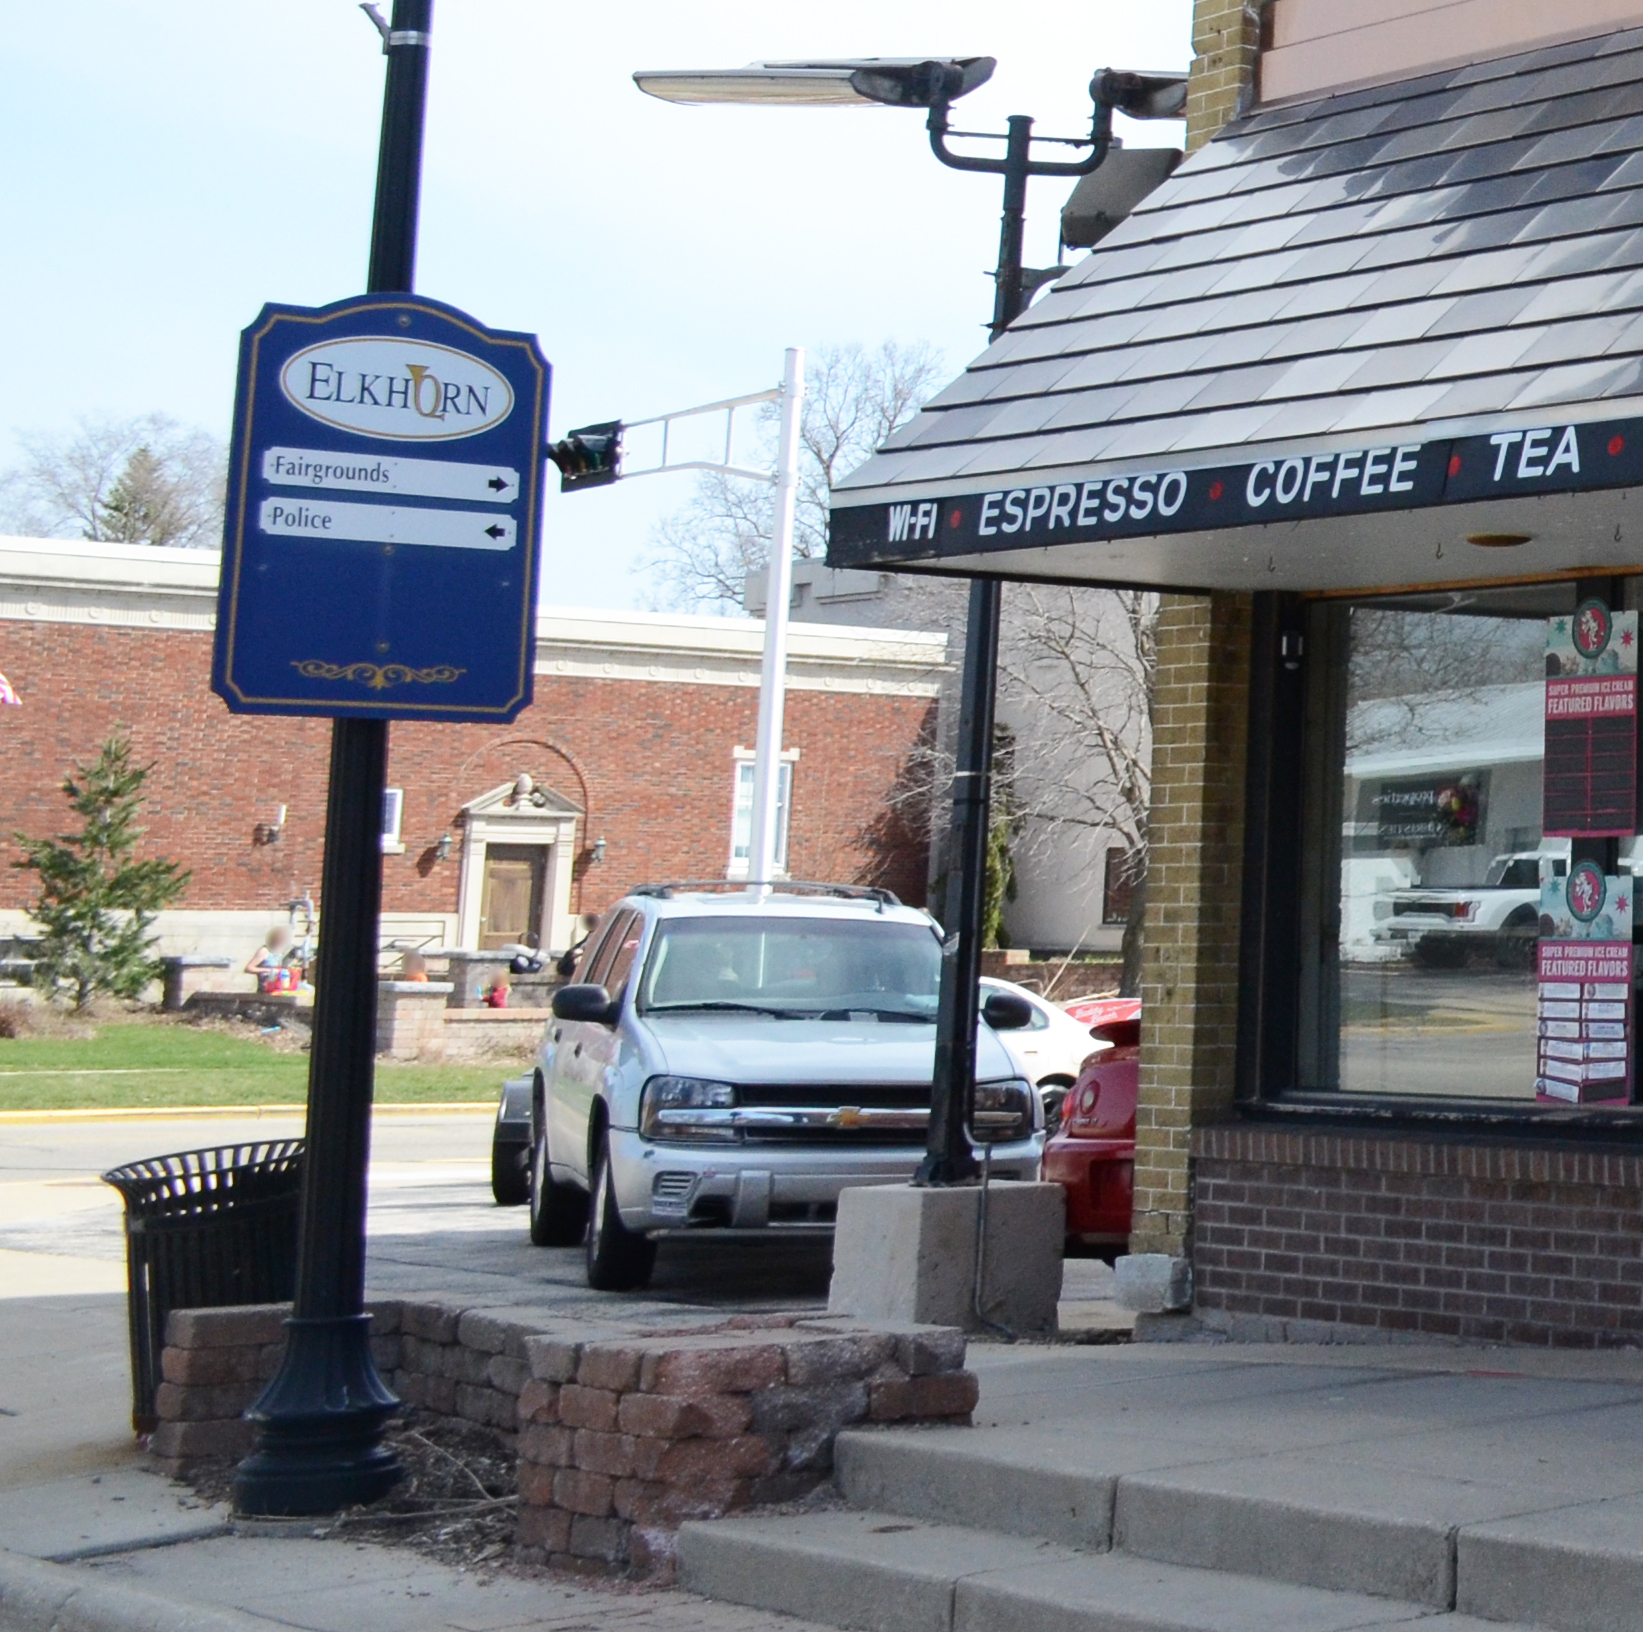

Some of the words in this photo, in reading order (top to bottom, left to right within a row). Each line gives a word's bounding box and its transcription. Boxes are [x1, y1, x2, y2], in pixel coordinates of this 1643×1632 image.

[305, 360, 492, 422] ELKHORN
[273, 454, 390, 485] Fairgrounds
[888, 502, 938, 542] WI-FI
[978, 470, 1189, 536] ESPRESSO
[1245, 443, 1424, 508] COFFEE
[1489, 425, 1581, 482] TEA
[271, 505, 333, 531] Police
[1547, 695, 1593, 714] FEATURED
[1593, 693, 1634, 712] FLAVORS
[1541, 959, 1586, 976] FEATURED
[1587, 959, 1629, 977] FLAVORS
